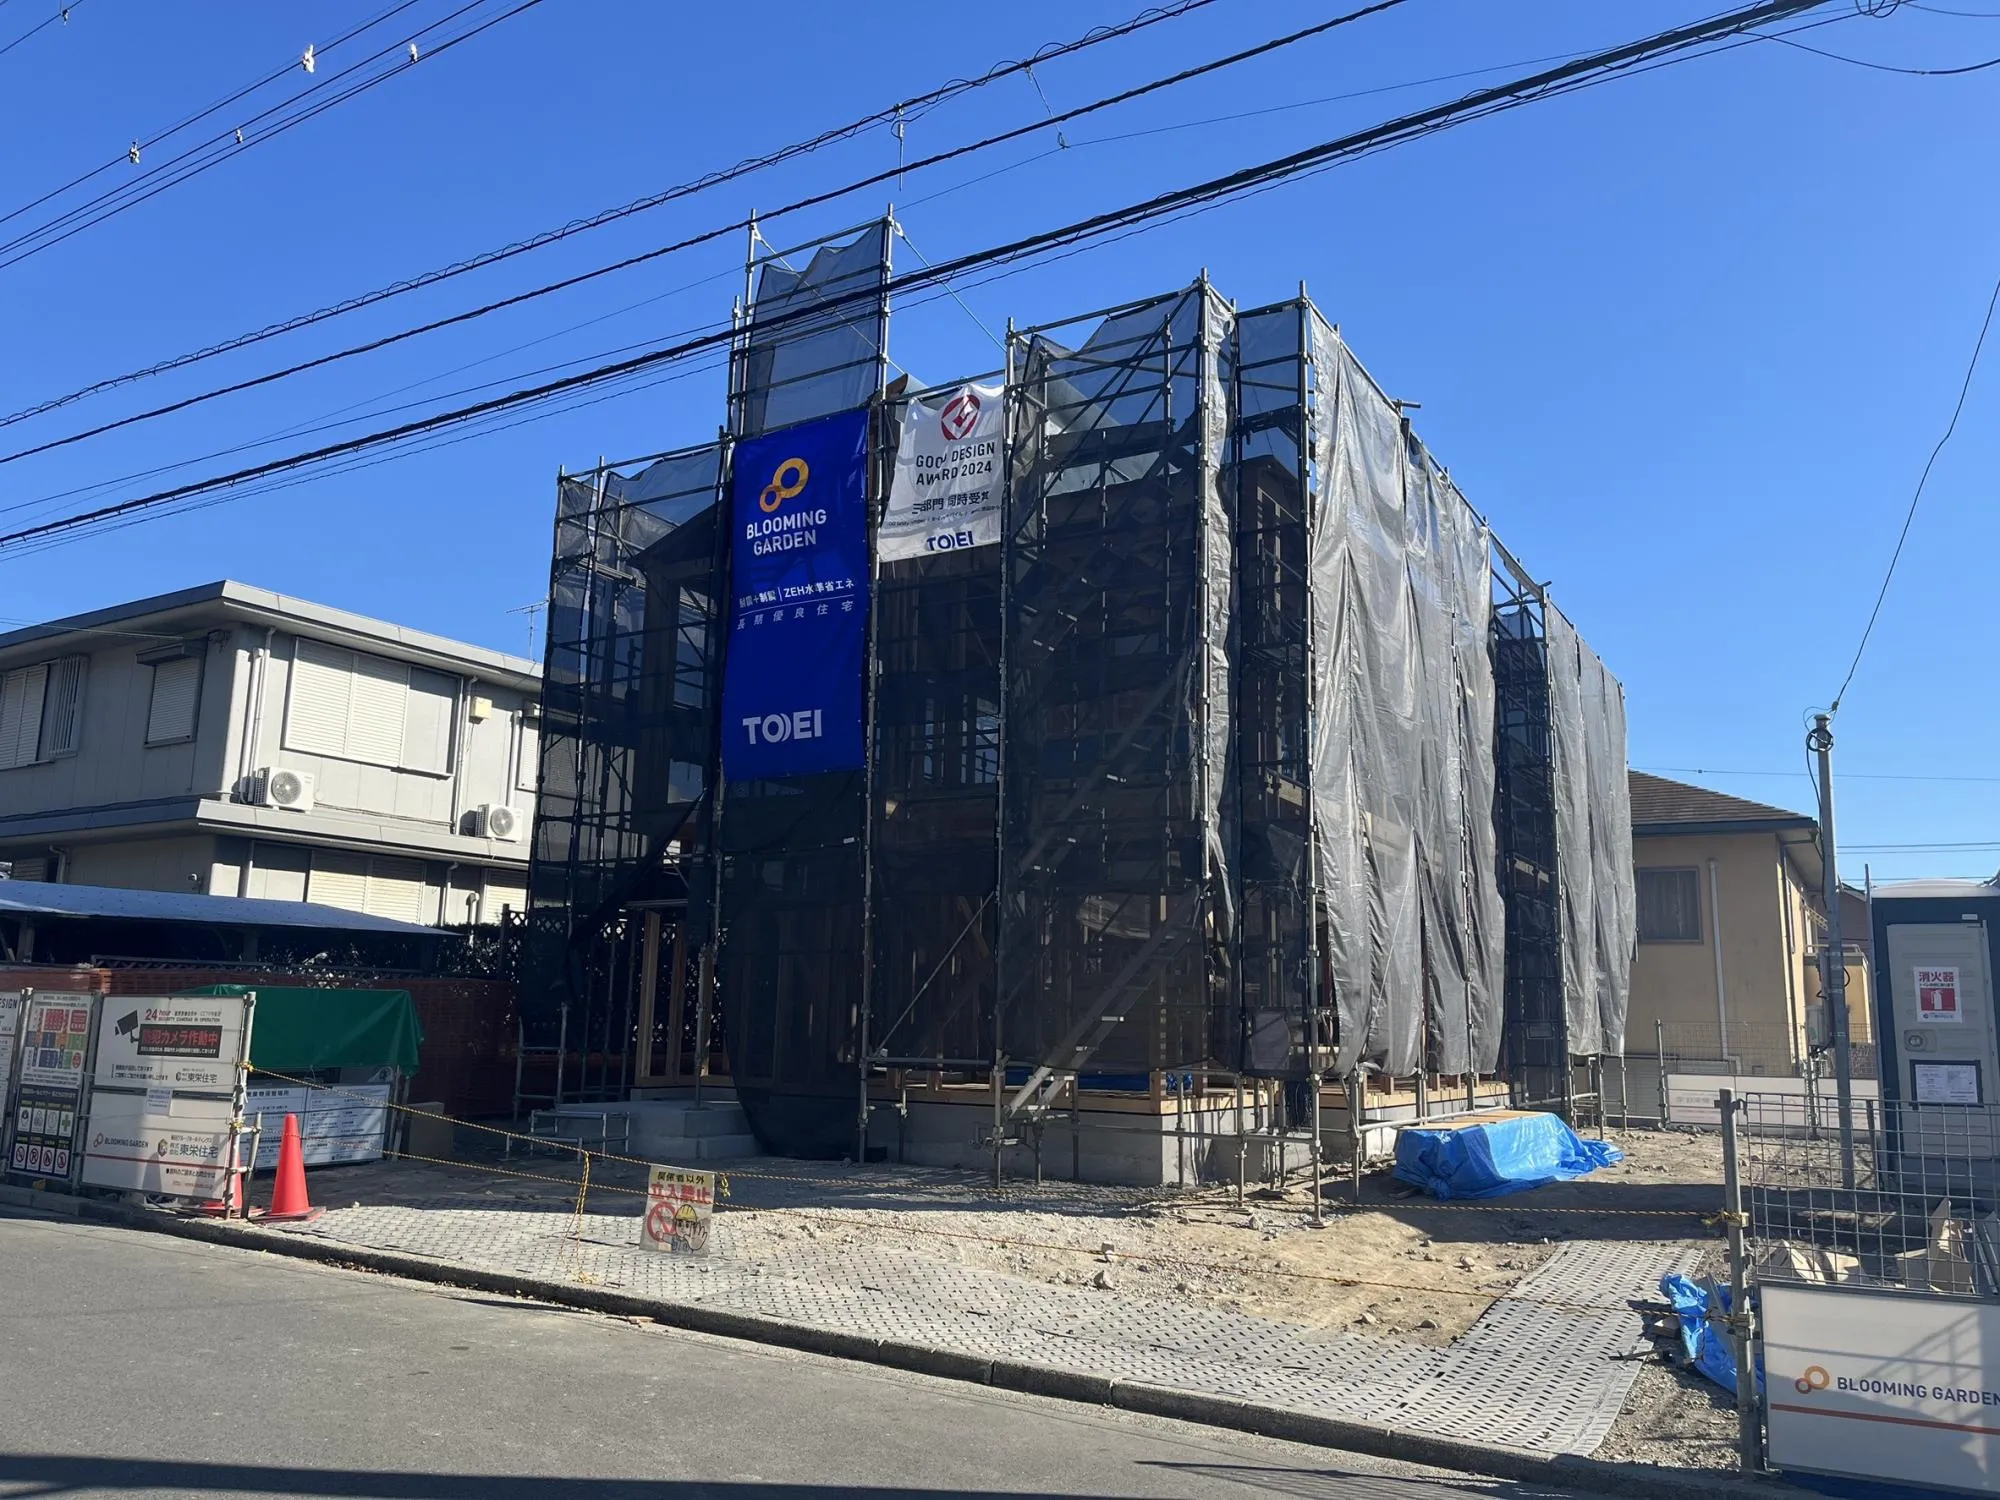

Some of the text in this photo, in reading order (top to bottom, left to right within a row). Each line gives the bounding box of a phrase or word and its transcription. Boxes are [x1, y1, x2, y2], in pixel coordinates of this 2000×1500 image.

[952, 442, 995, 462] DESIGN
[961, 460, 992, 477] 2024
[746, 508, 827, 540] BLOOMING
[753, 529, 817, 556] GARDEN
[1919, 971, 1954, 982] 消火器
[145, 1008, 158, 1021] 24
[180, 1144, 219, 1159] 東栄住宅
[657, 1171, 705, 1185] 関係者以外
[651, 1183, 711, 1203] 立入禁止
[1837, 1376, 1927, 1399] BLOOMING
